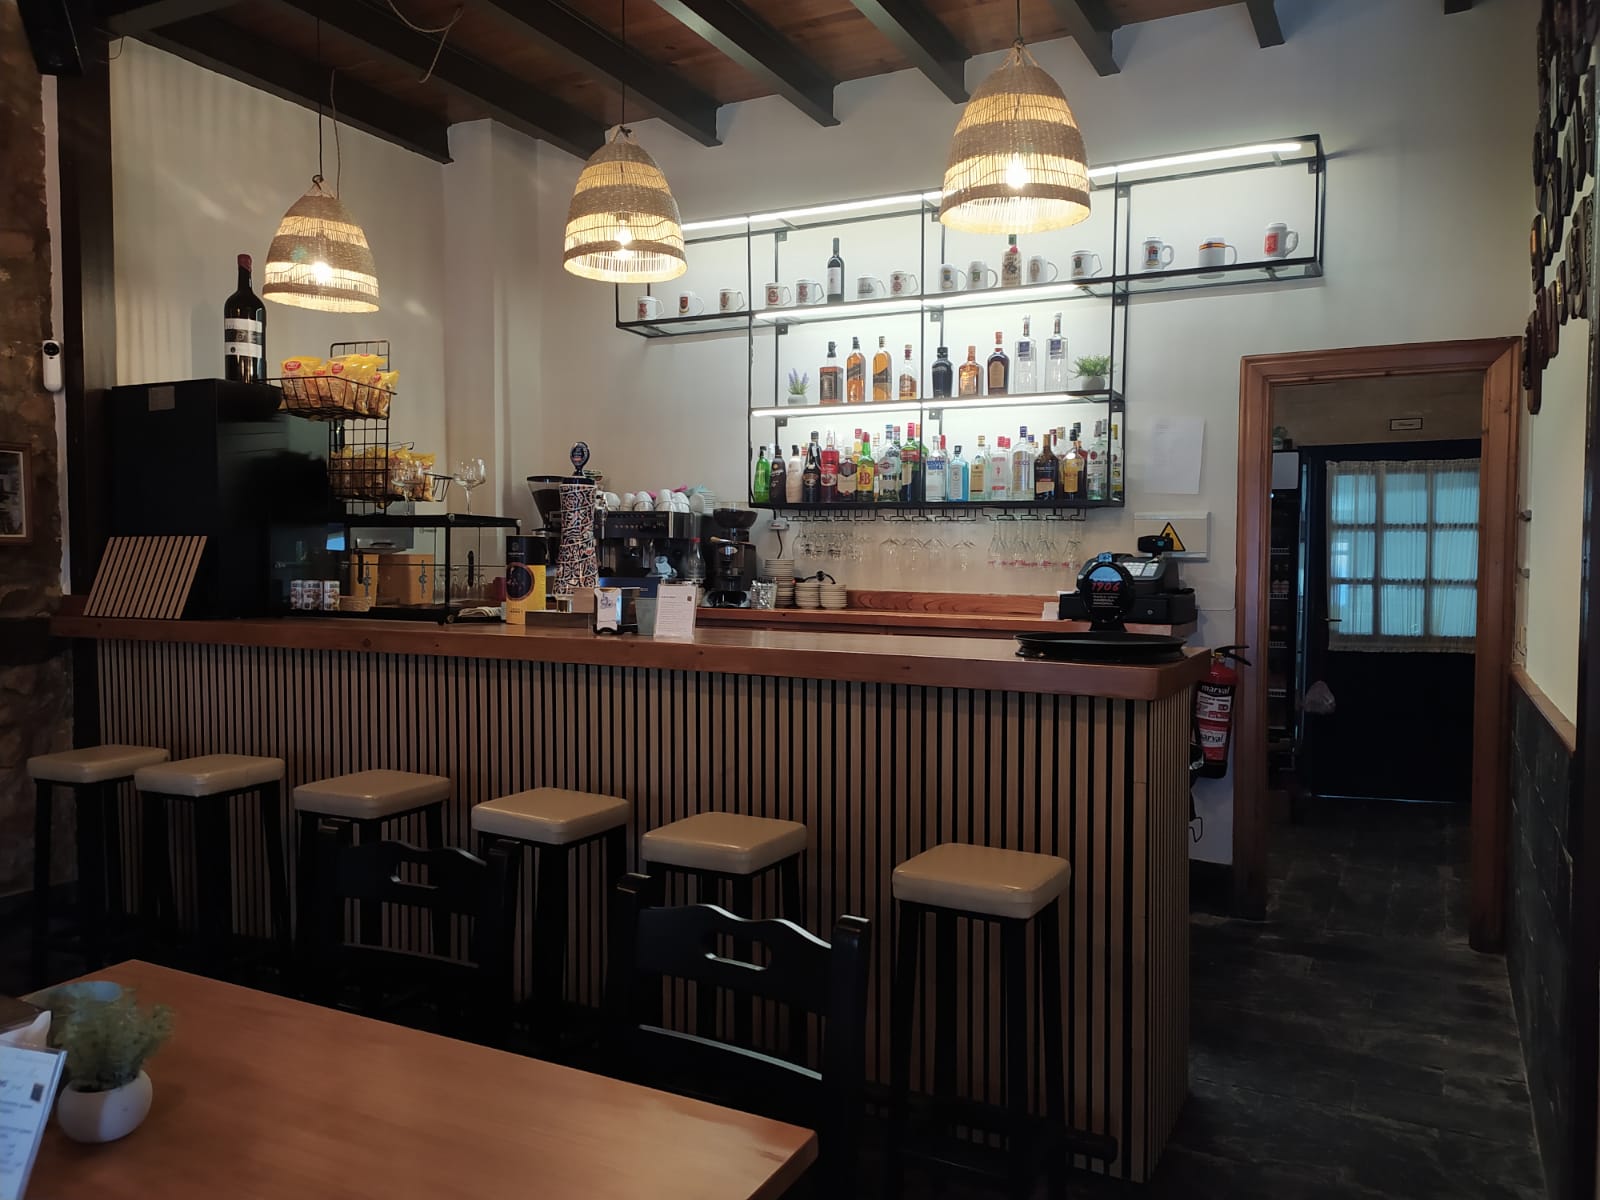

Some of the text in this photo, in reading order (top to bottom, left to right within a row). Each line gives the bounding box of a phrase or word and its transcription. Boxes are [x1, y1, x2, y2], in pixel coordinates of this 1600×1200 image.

[1091, 582, 1121, 593] 1906
[1201, 685, 1230, 695] marval
[1201, 733, 1223, 744] arval
